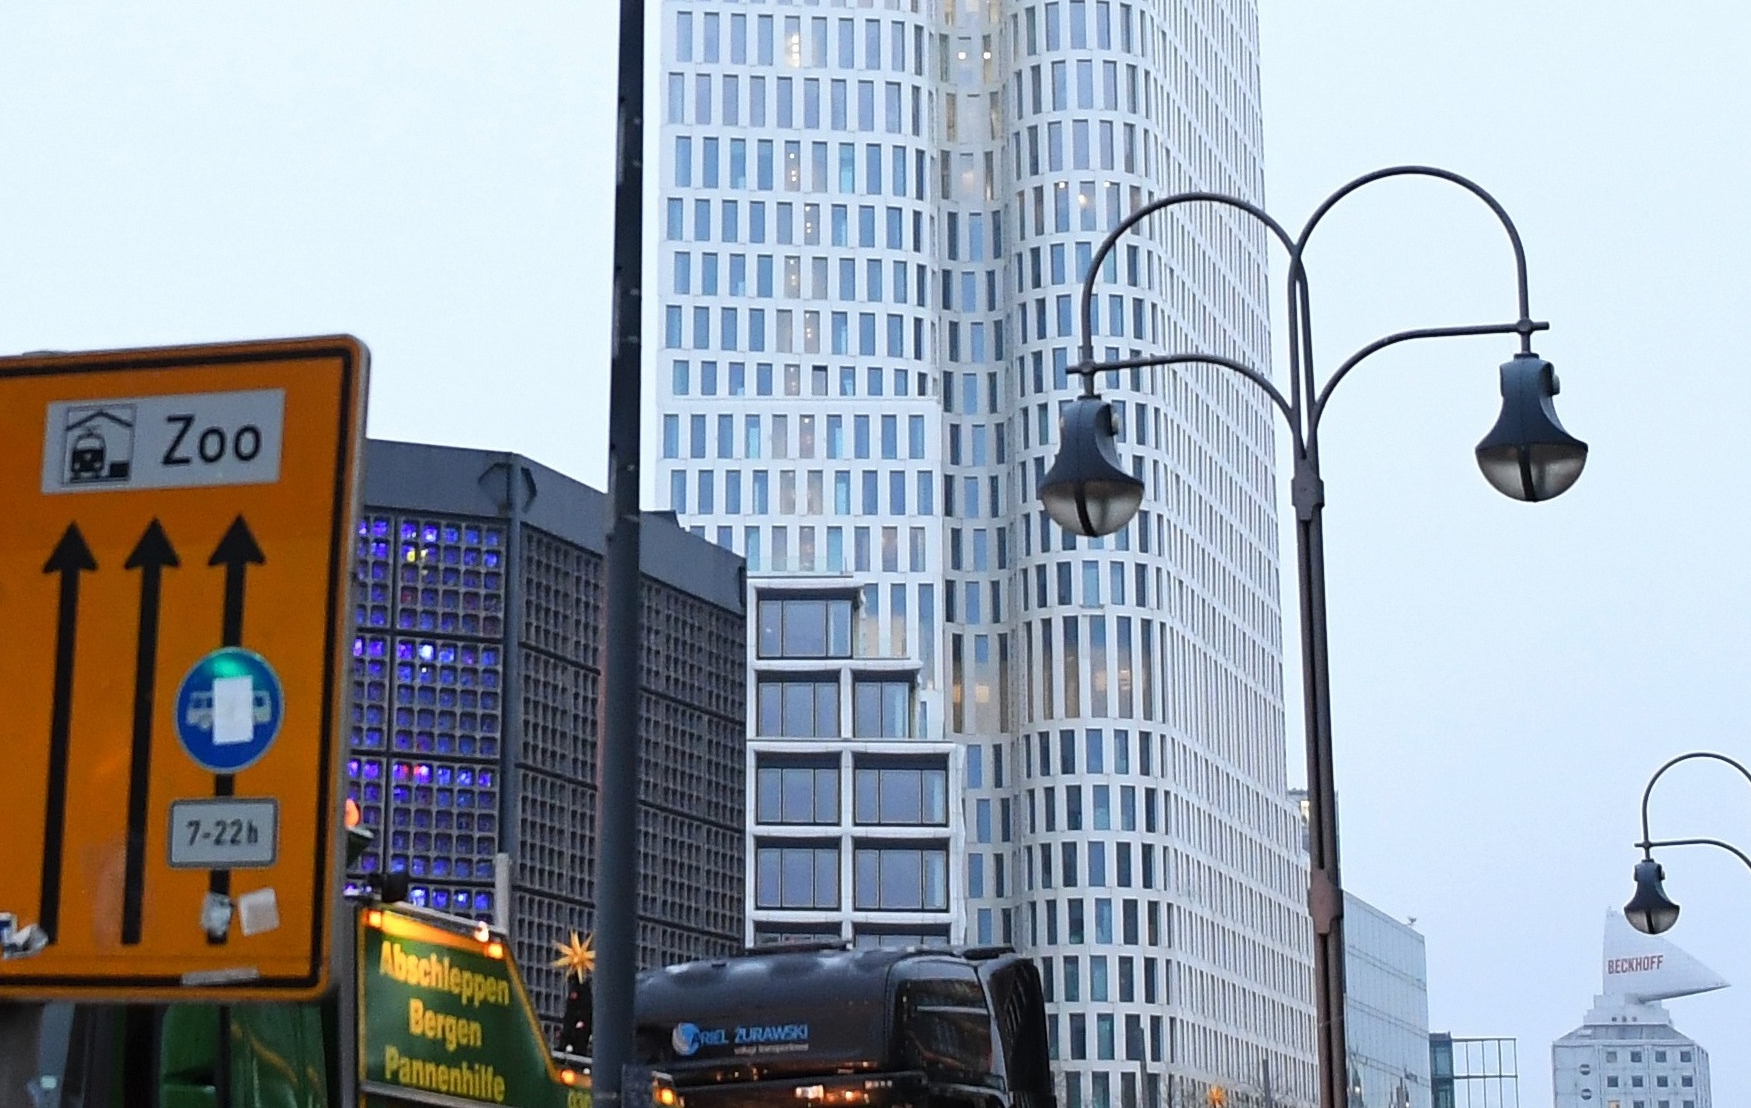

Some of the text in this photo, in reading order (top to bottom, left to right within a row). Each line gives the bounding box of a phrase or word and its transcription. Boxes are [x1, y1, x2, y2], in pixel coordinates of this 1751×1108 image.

[162, 413, 263, 466] Zoo
[379, 941, 510, 1008] Abschleppen
[1608, 955, 1664, 975] BECKHOFF
[409, 998, 482, 1053] Bergen
[385, 1045, 506, 1102] Pannenhilfe
